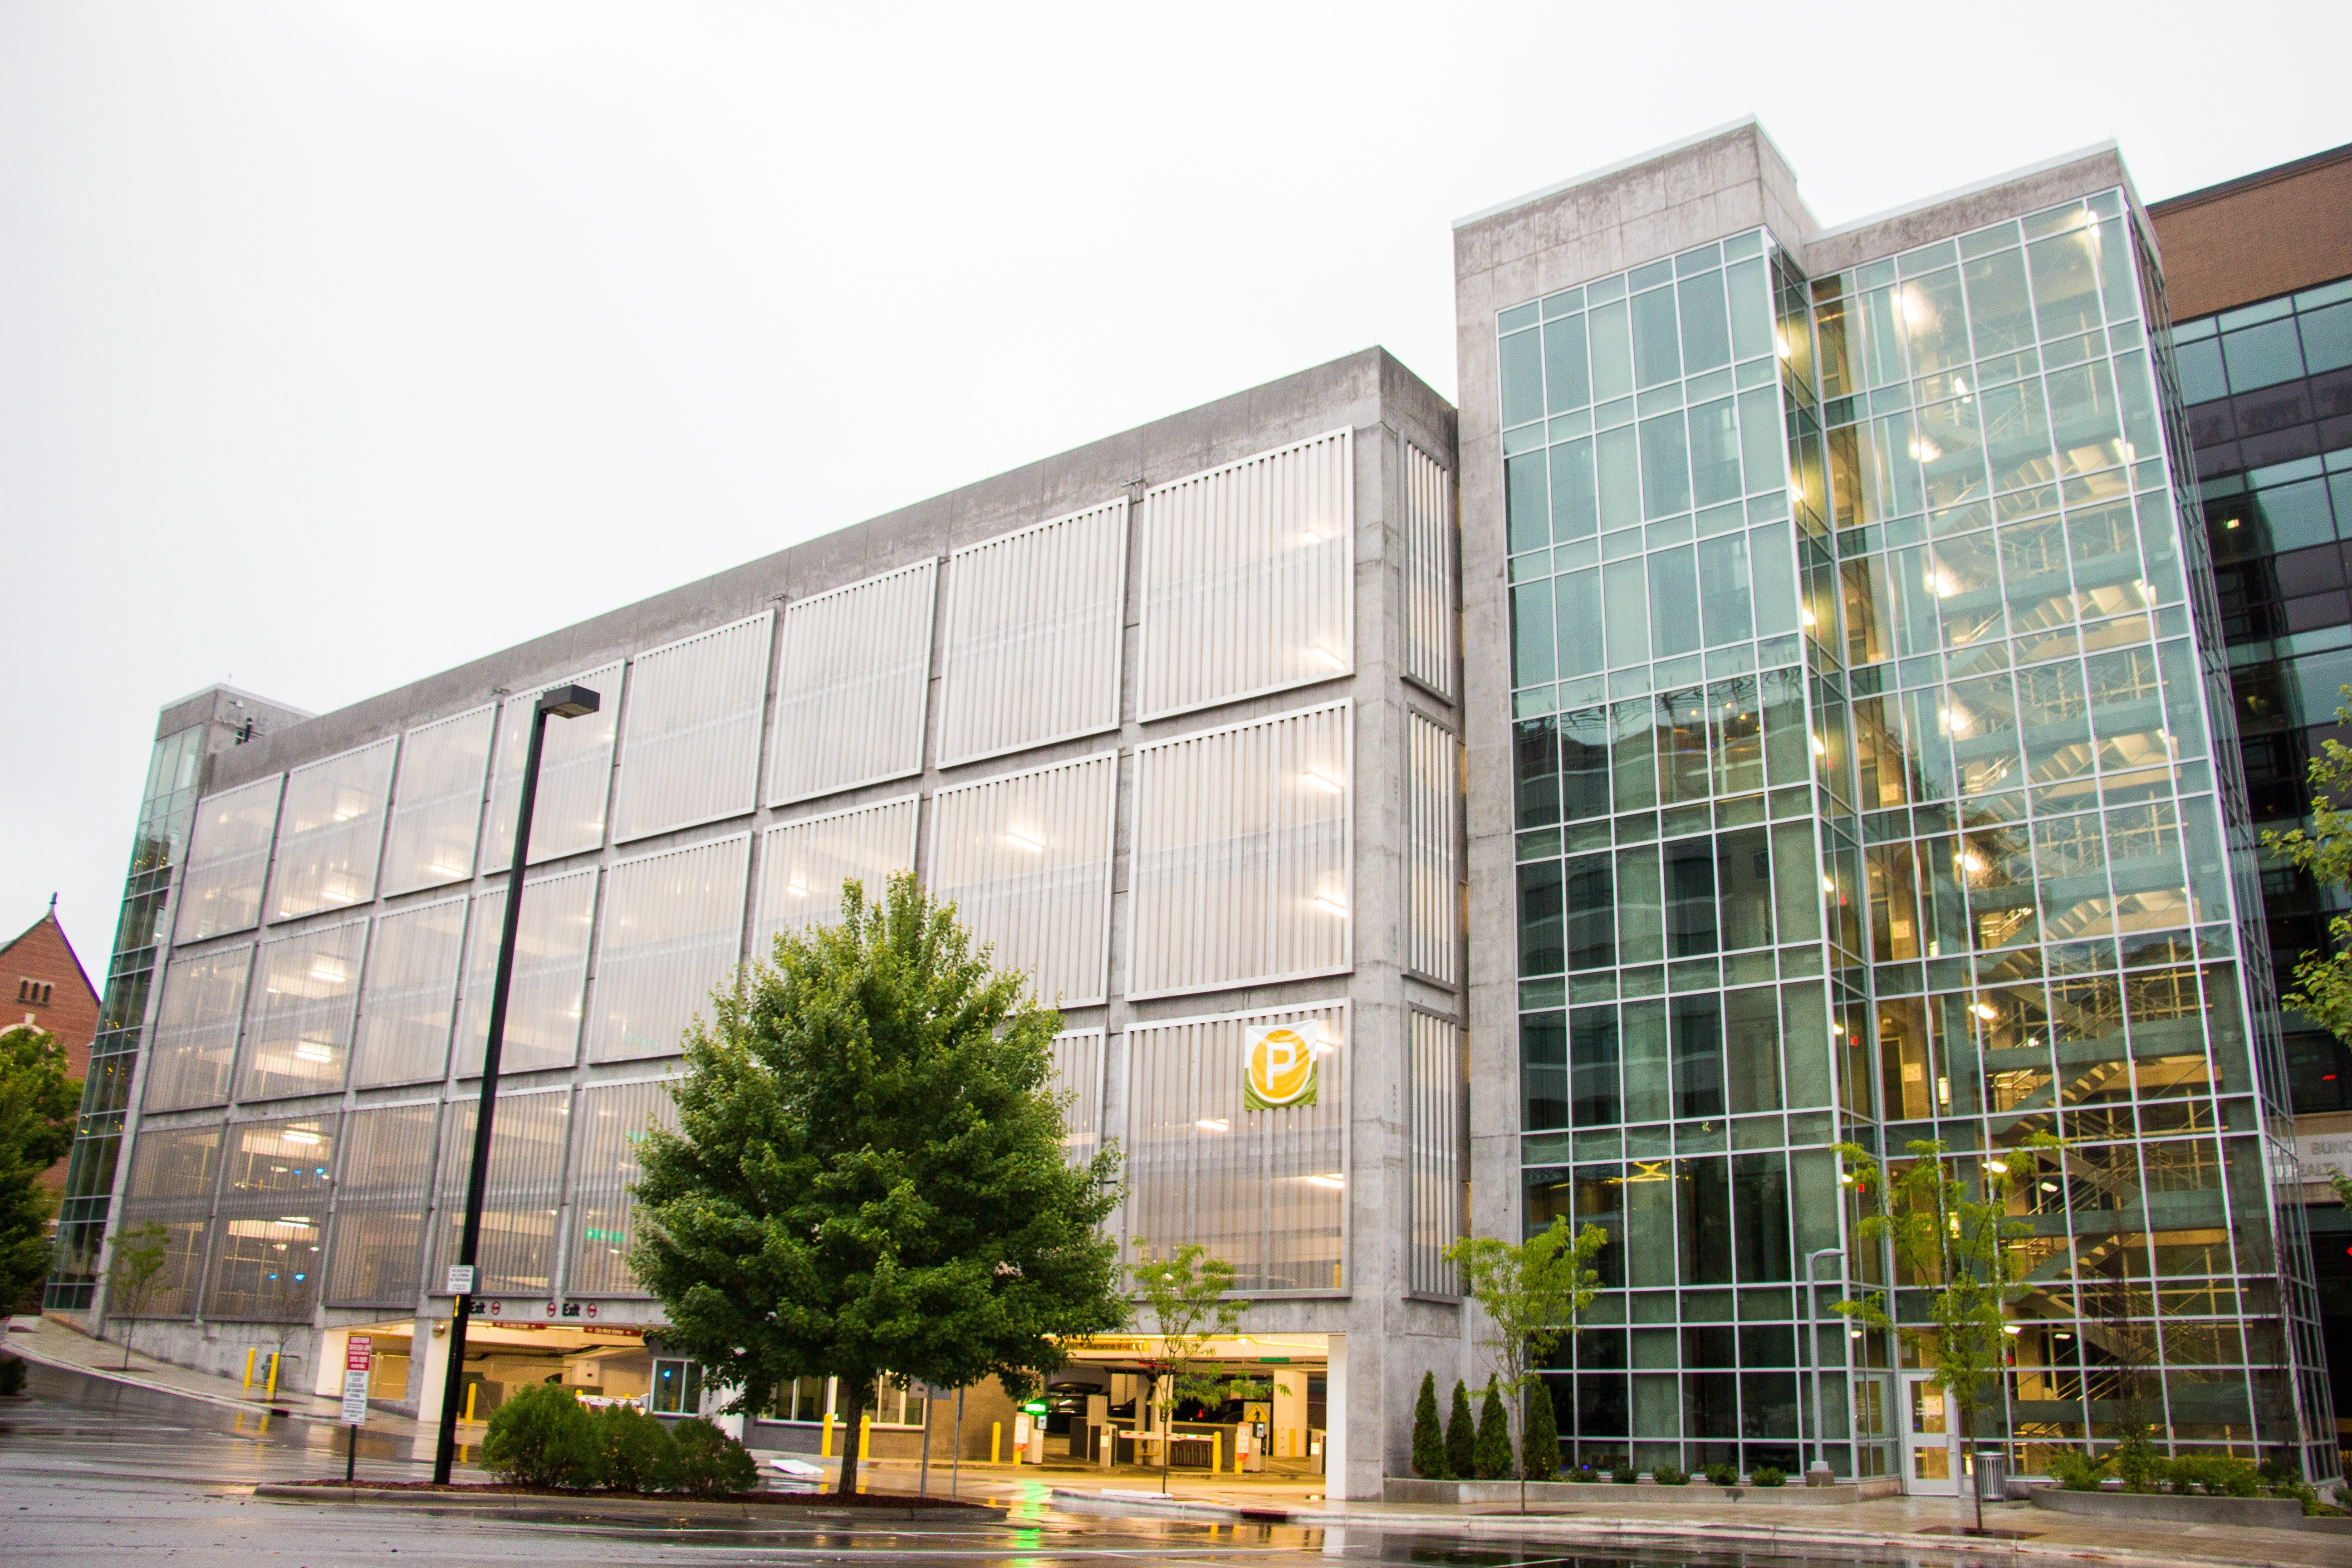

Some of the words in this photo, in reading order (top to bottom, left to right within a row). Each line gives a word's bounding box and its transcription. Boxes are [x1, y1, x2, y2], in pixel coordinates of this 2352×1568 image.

[1267, 1042, 1296, 1089] P
[469, 1301, 485, 1314] Exit
[562, 1303, 579, 1317] Exit
